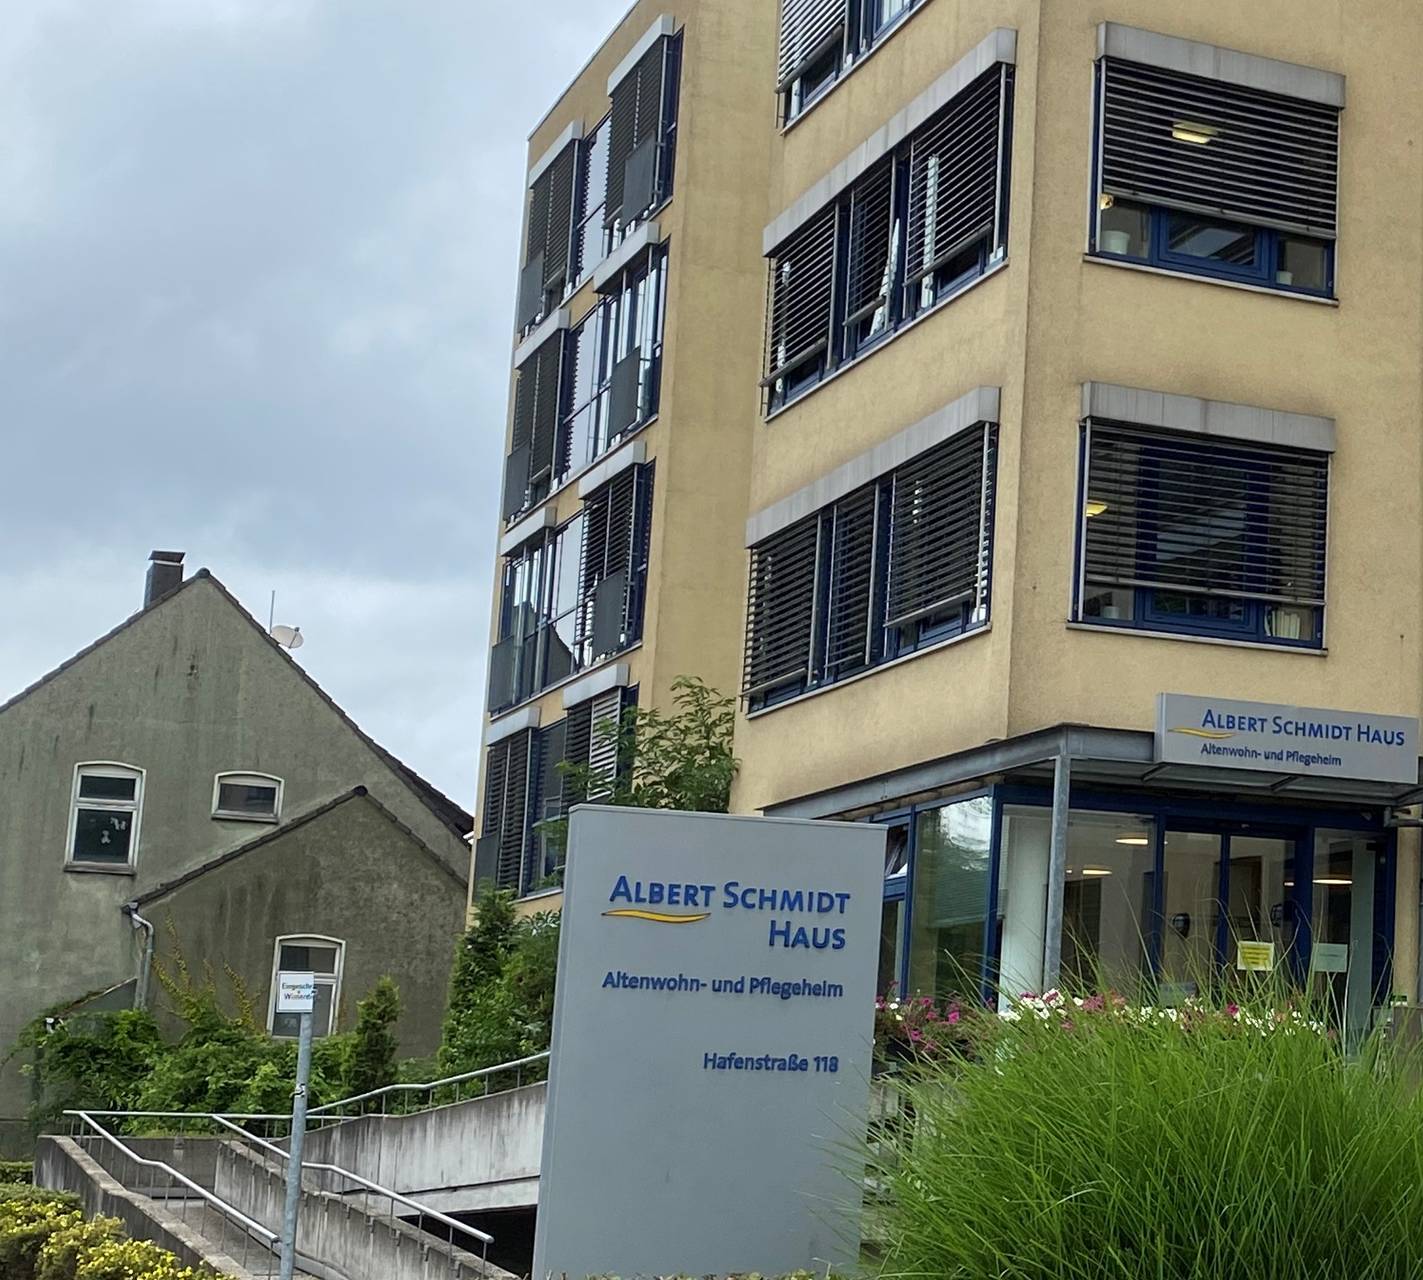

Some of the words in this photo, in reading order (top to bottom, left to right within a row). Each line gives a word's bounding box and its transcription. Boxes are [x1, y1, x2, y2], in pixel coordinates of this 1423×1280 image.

[1201, 708, 1267, 733] ALBERT
[1272, 716, 1353, 741] SCHMIDT
[1357, 723, 1405, 746] HAUS
[1200, 743, 1262, 759] Altenwohn-
[1264, 749, 1284, 761] und
[1286, 750, 1342, 766] Pflegeheim
[608, 874, 716, 908] ALBERT
[723, 881, 851, 914] SCHMIDT
[768, 919, 846, 949] HAUS
[602, 971, 707, 992] Altenwohn-
[711, 976, 744, 994] und
[749, 977, 843, 1000] Pflegeheim
[703, 1052, 809, 1072] Hafenstraße
[813, 1055, 840, 1073] 118
